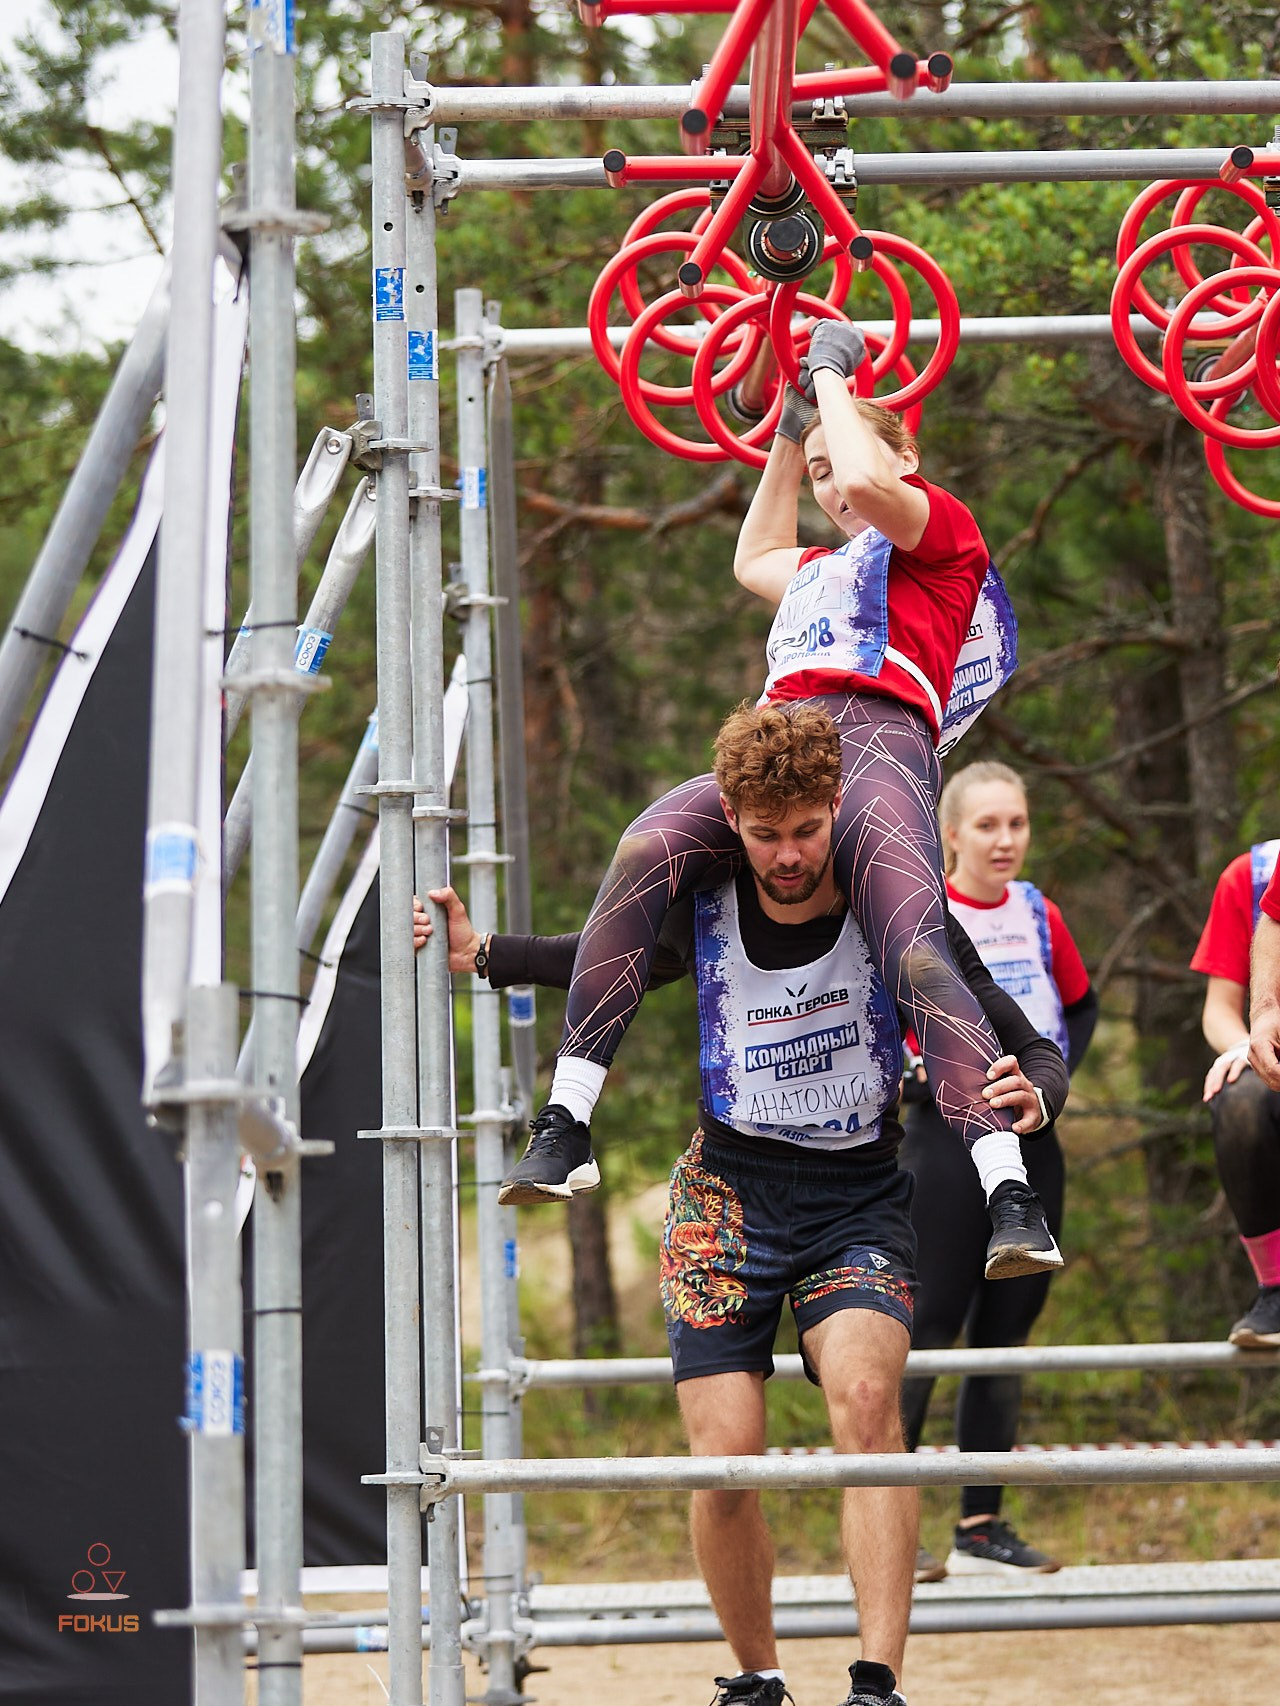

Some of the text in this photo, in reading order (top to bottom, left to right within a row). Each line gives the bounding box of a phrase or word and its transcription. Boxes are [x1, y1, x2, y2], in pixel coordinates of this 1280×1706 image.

[299, 636, 315, 665] СОЮЗ
[747, 988, 849, 1021] ГОНКА ГЕРОЕВ
[747, 1023, 857, 1069] КОМАНДНЫЙ
[778, 1054, 828, 1078] СТАРТ
[749, 1075, 868, 1121] АНАТОЛИЙ
